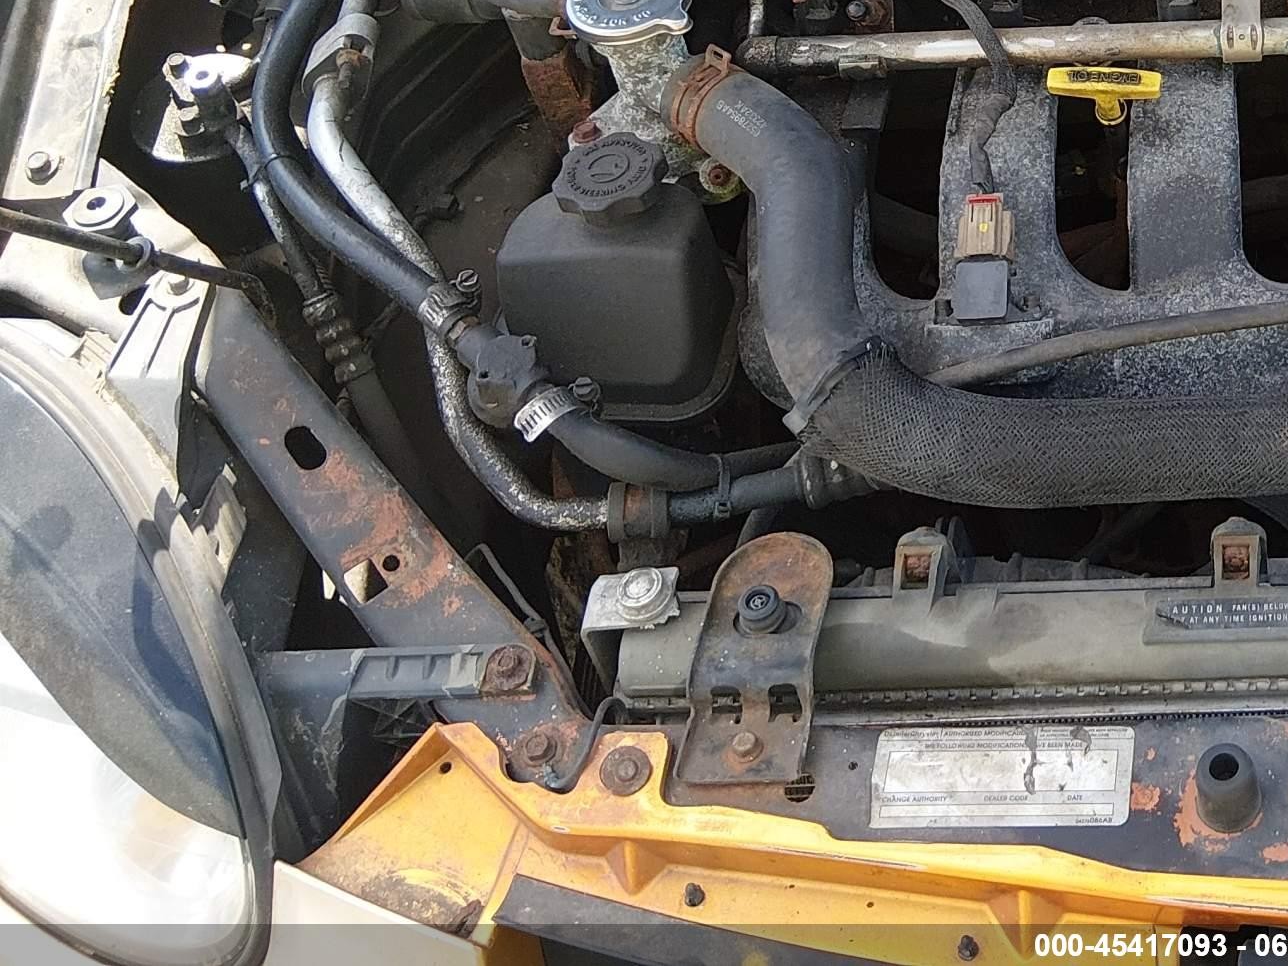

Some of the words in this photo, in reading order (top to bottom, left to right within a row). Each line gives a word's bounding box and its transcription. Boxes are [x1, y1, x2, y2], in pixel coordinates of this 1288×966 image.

[1067, 70, 1090, 84] OIL
[1090, 71, 1140, 85] ENGINE
[1167, 605, 1223, 615] AUTION
[1224, 615, 1245, 623] TIME
[1248, 613, 1288, 622] IGNITION
[880, 795, 911, 803] CHANGE
[911, 795, 948, 803] AUTHORITY
